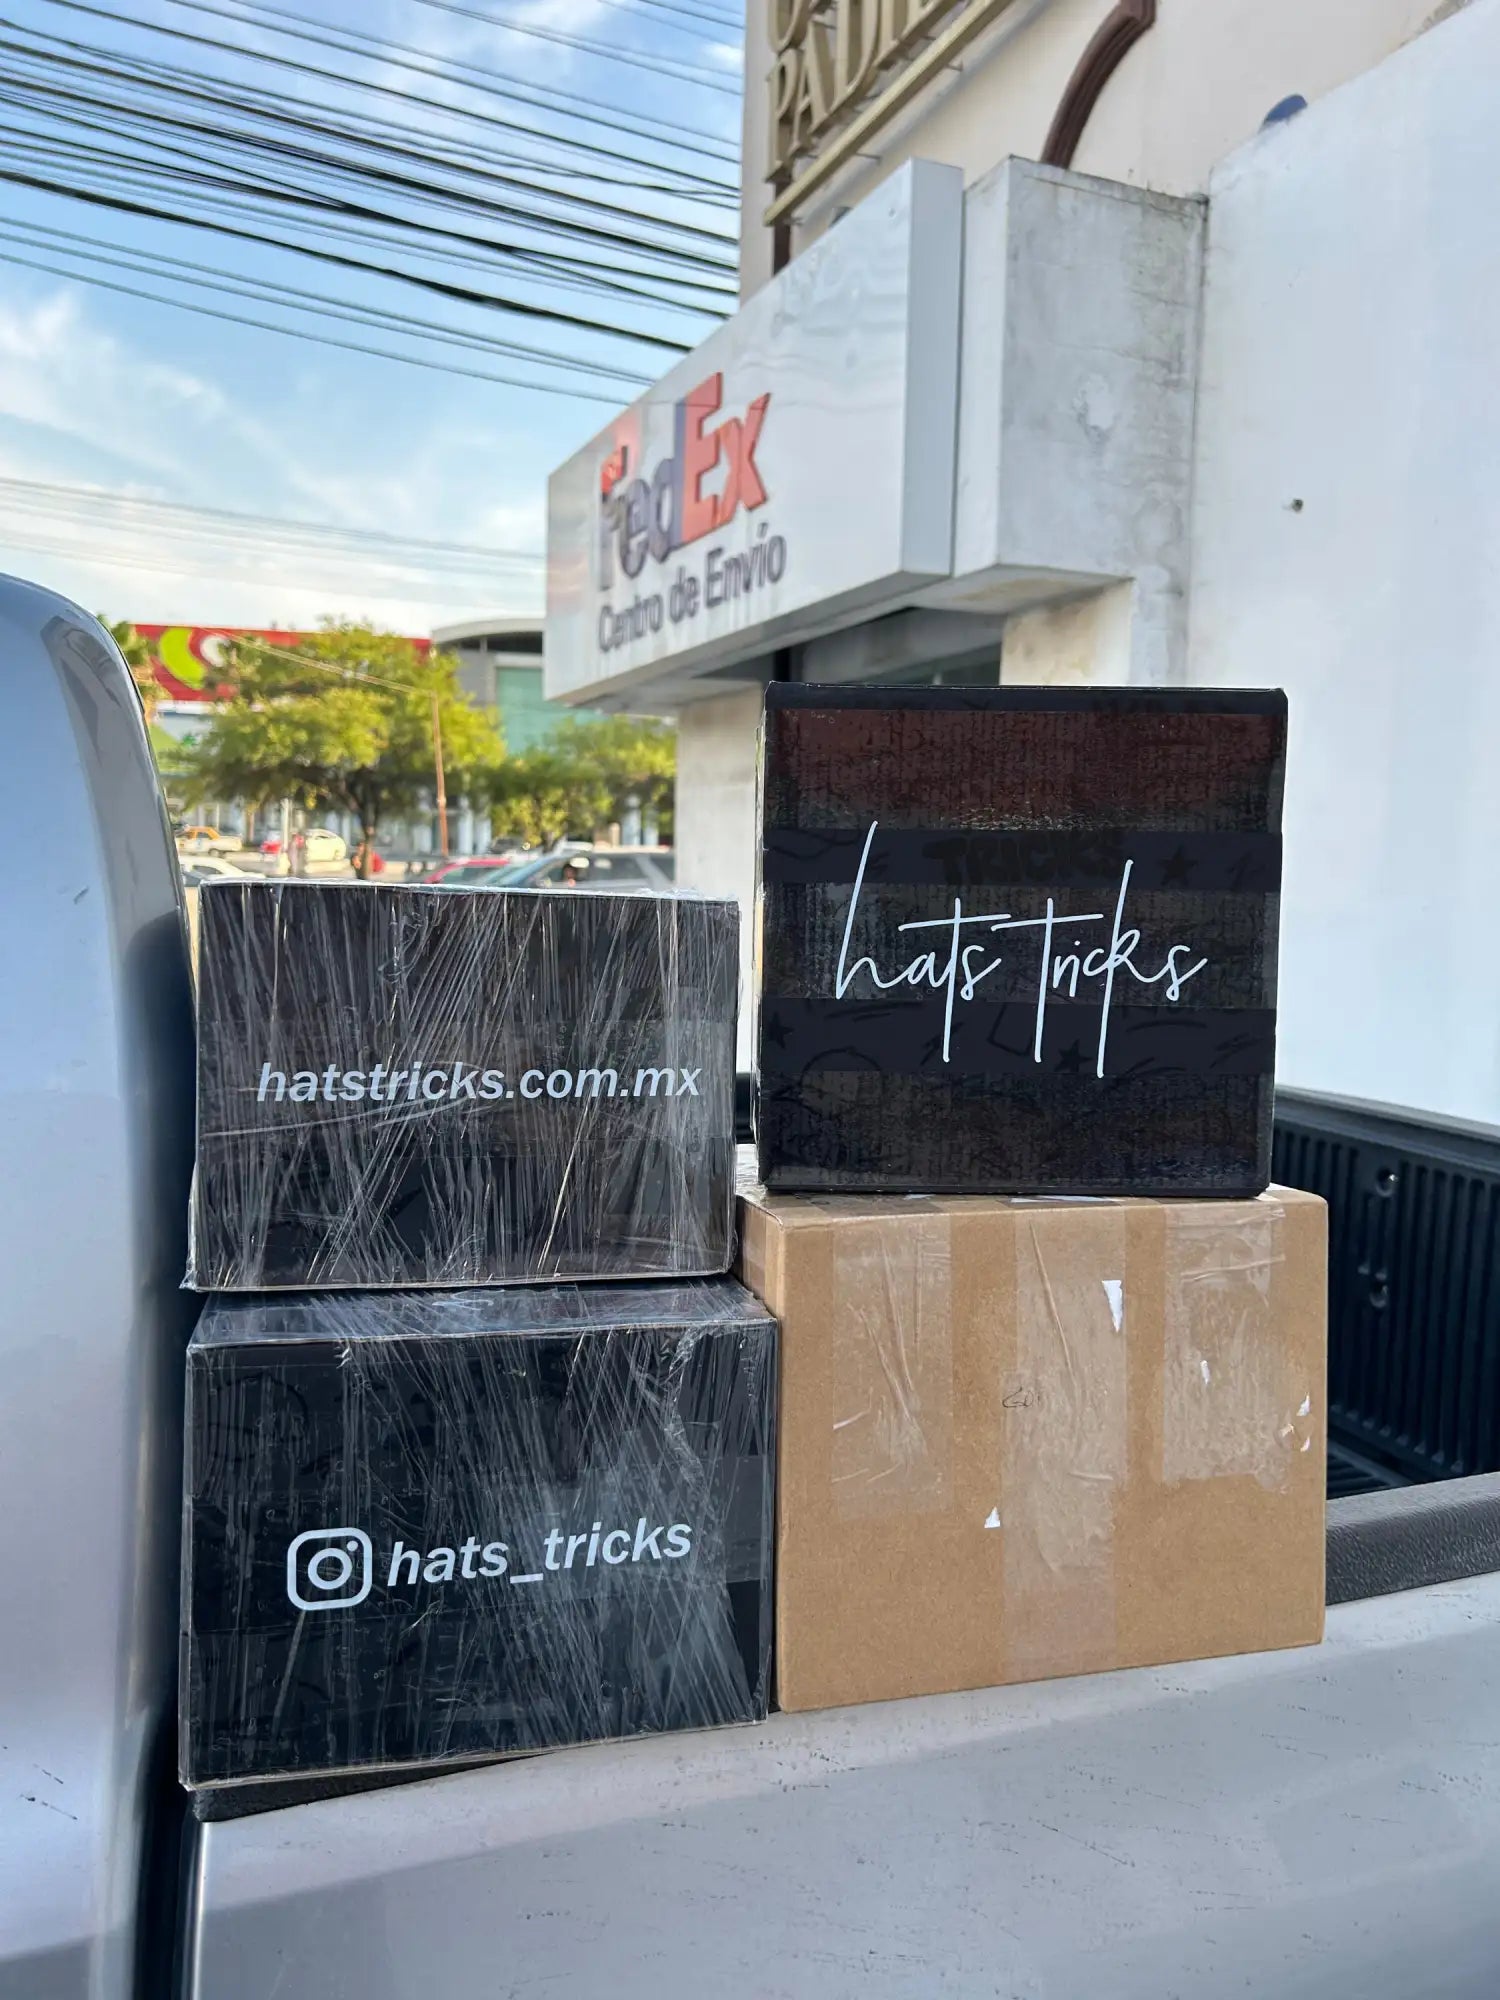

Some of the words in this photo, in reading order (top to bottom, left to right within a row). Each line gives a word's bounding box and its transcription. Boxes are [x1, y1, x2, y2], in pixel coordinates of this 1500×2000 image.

[600, 372, 771, 591] FedEx
[599, 594, 664, 653] Centro
[669, 567, 699, 623] de
[706, 523, 787, 608] Envío
[836, 820, 1011, 1063] hats
[257, 1060, 702, 1102] hatstricks.com.mx
[387, 1517, 692, 1587] hats_tricks
